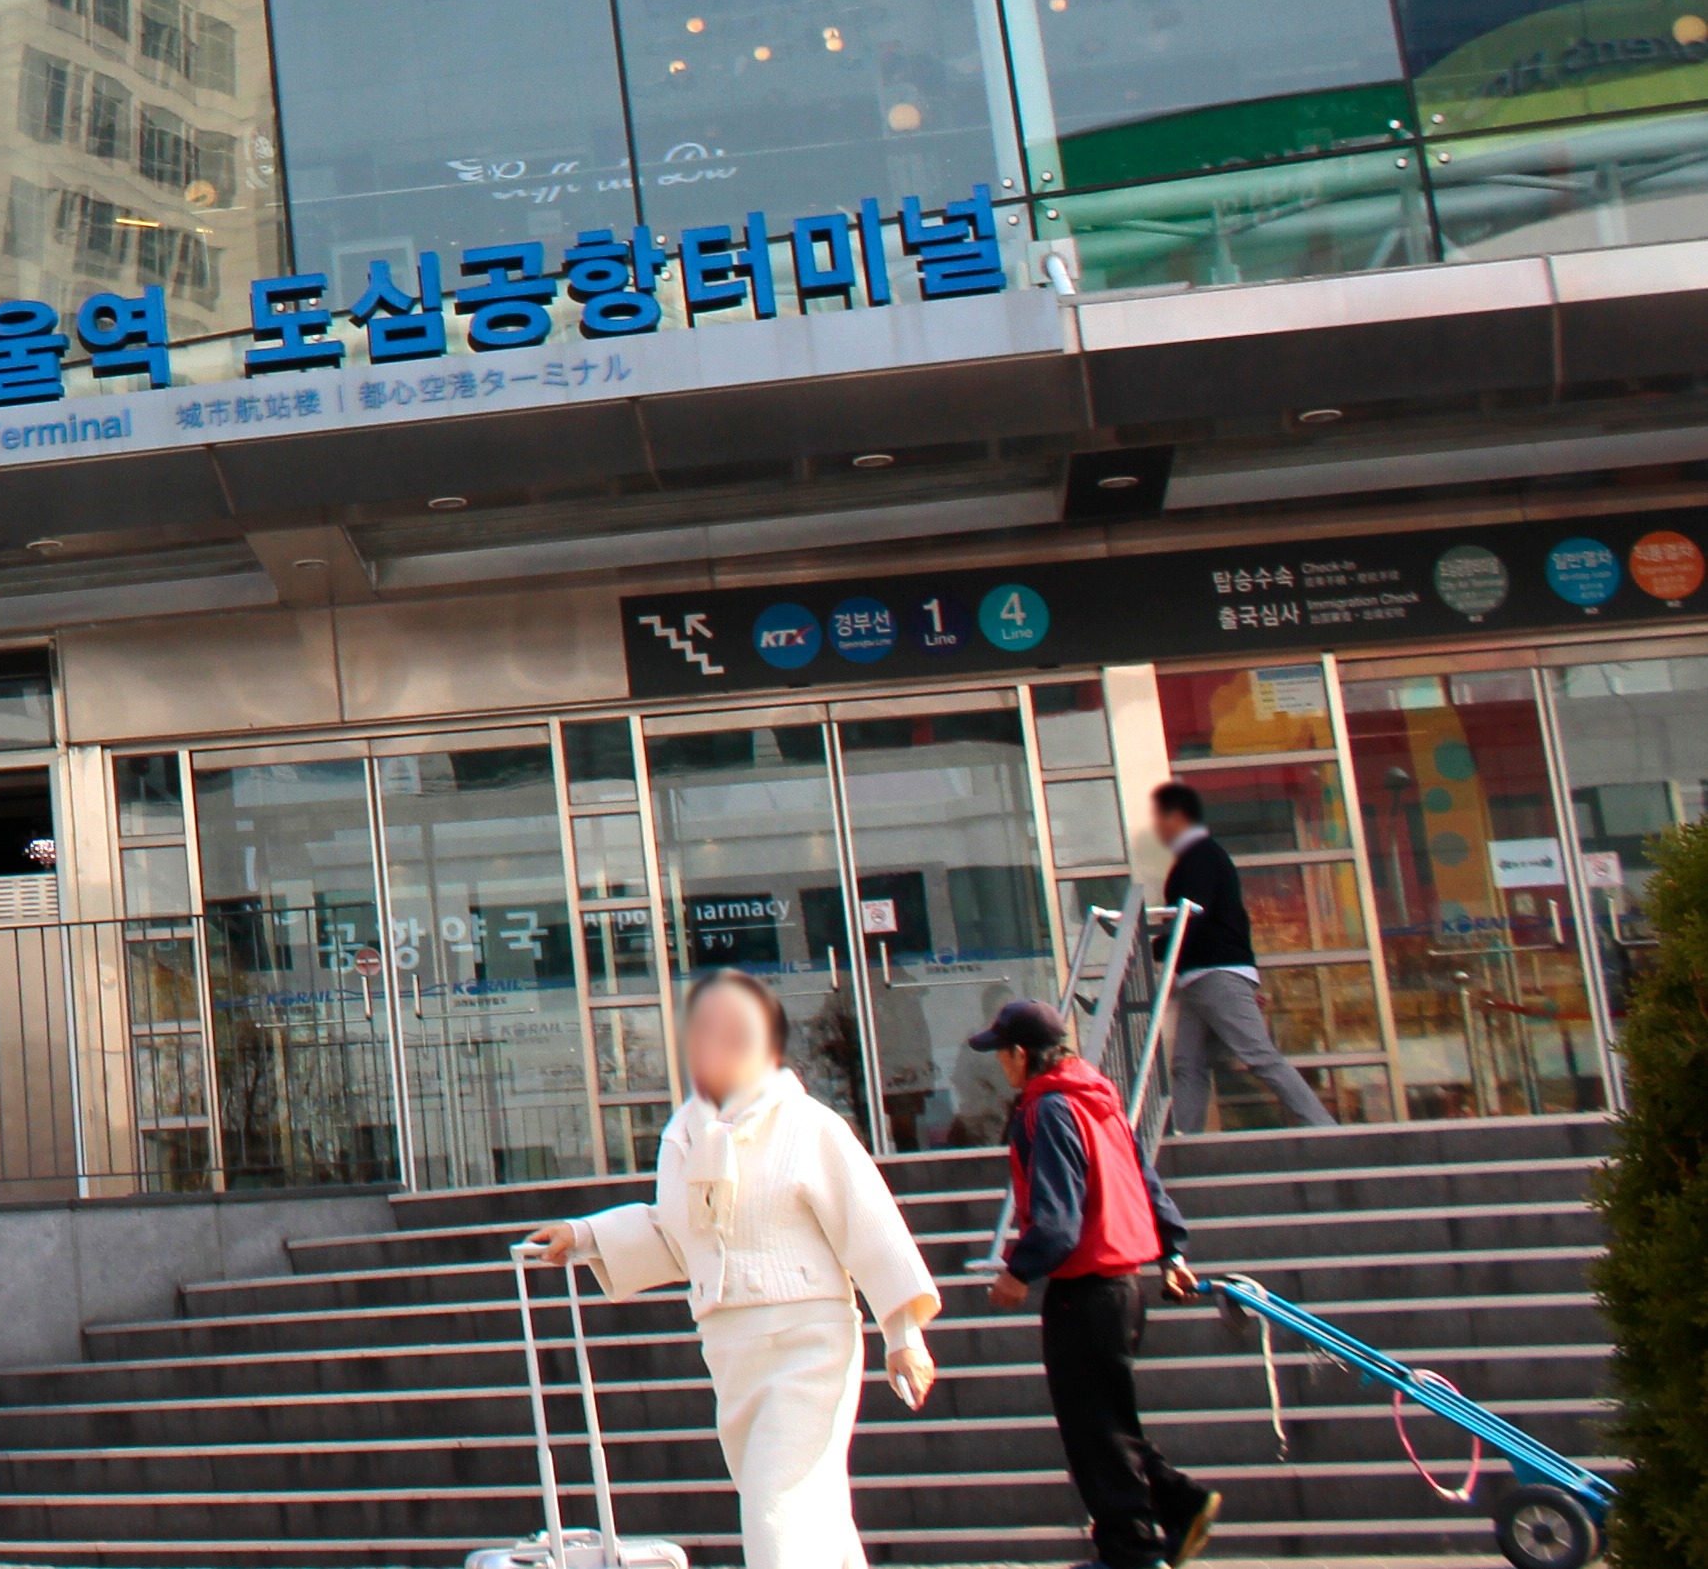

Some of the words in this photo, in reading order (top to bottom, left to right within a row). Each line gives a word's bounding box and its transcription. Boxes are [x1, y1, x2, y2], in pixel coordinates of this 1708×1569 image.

[245, 184, 1008, 371] 도심공항터미널
[359, 352, 631, 411] 都心空港ターミナル
[1212, 565, 1296, 594] 탑승수속
[922, 597, 944, 633] 1
[999, 591, 1028, 626] 4
[1218, 601, 1301, 631] 출국심사
[760, 624, 815, 648] KTX
[834, 609, 891, 638] 경부선
[1001, 628, 1033, 641] Line
[924, 633, 957, 647] Line
[453, 978, 523, 996] KORAIL
